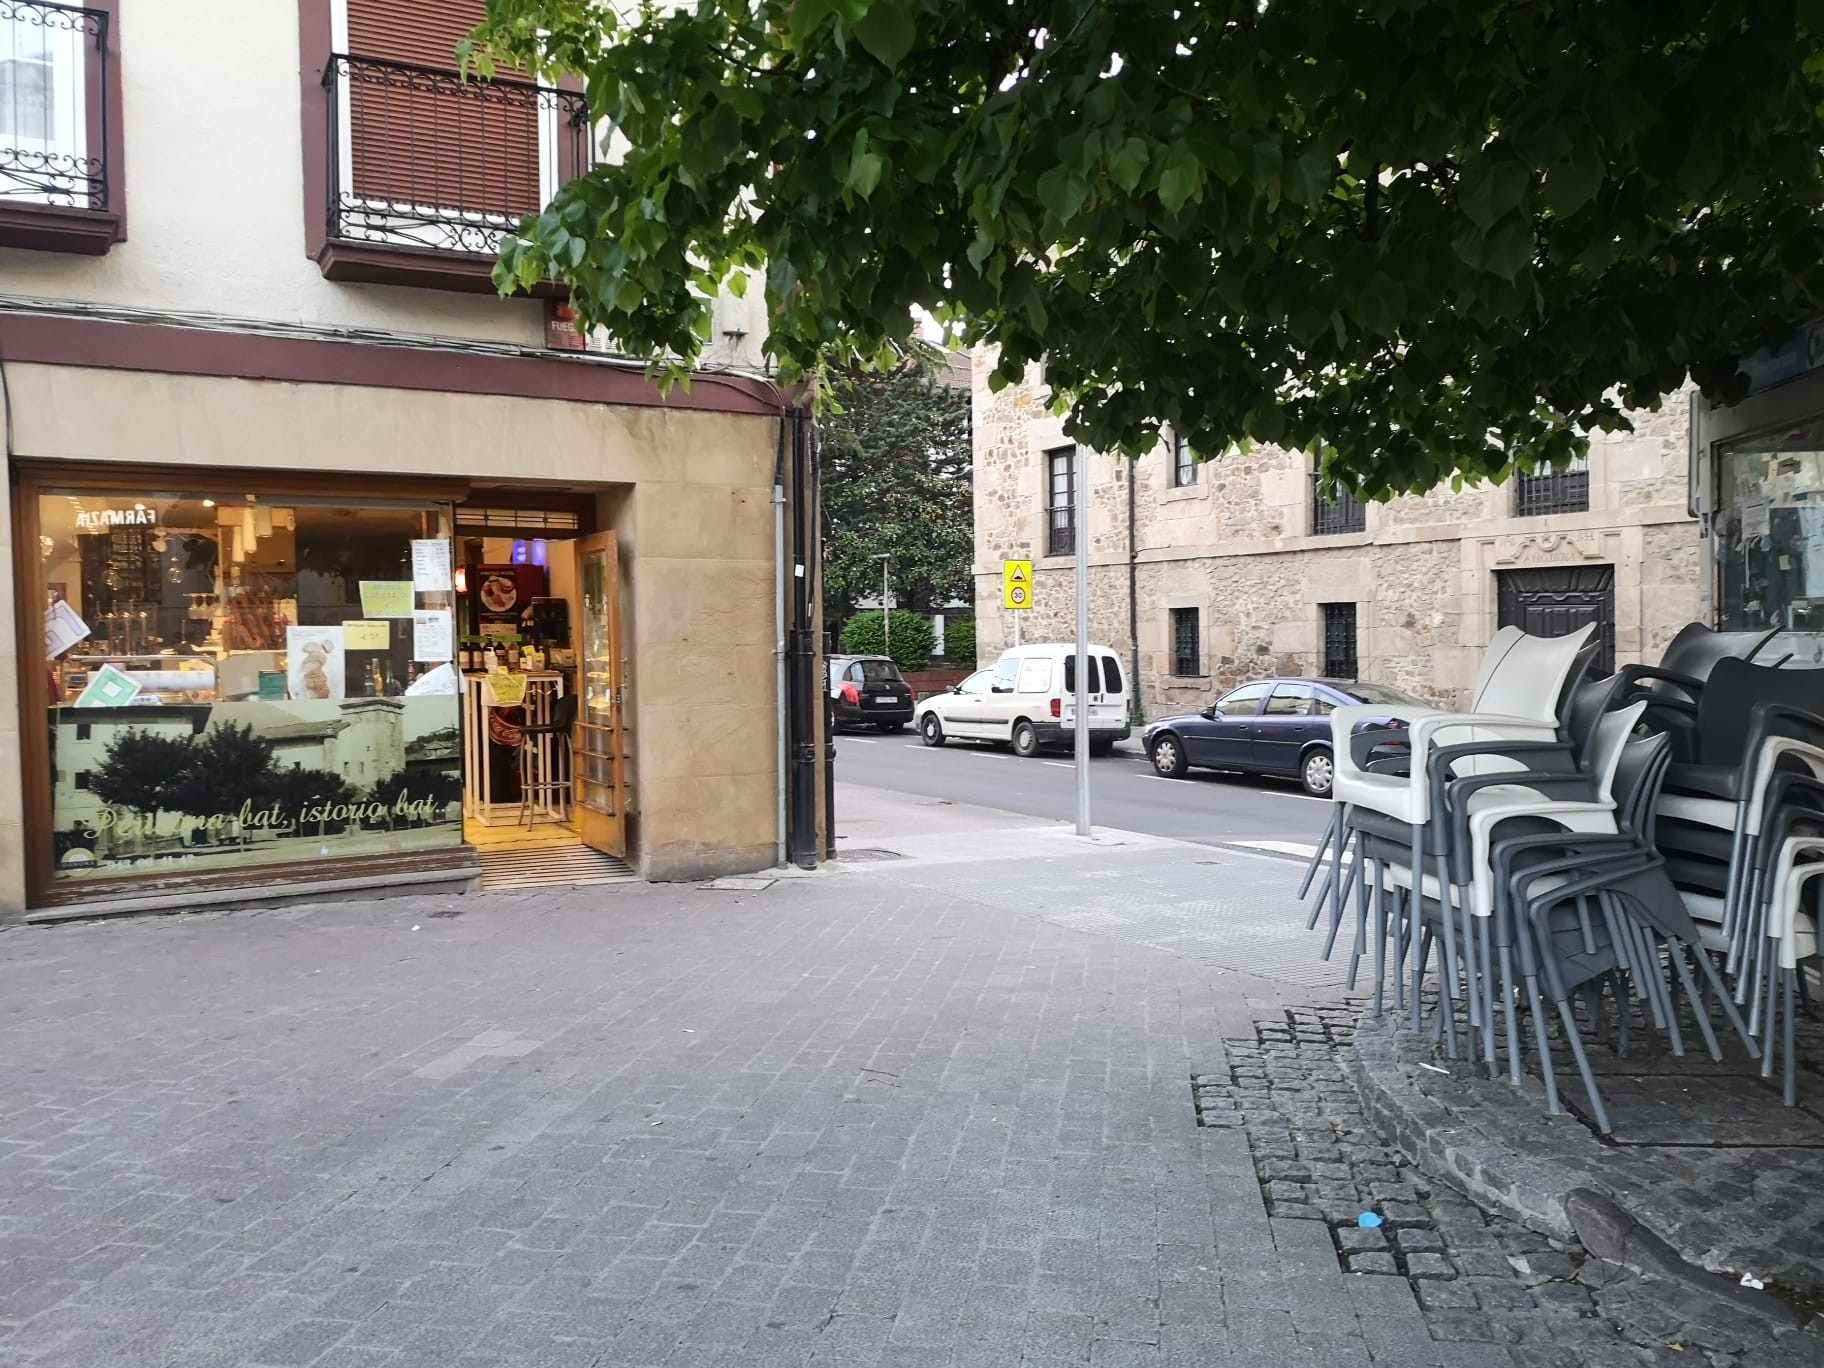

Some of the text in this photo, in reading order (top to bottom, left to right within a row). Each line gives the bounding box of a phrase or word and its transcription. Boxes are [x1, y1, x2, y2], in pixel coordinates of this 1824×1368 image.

[551, 320, 578, 332] FUEG
[239, 798, 288, 829] bat,
[300, 800, 383, 823] istorio
